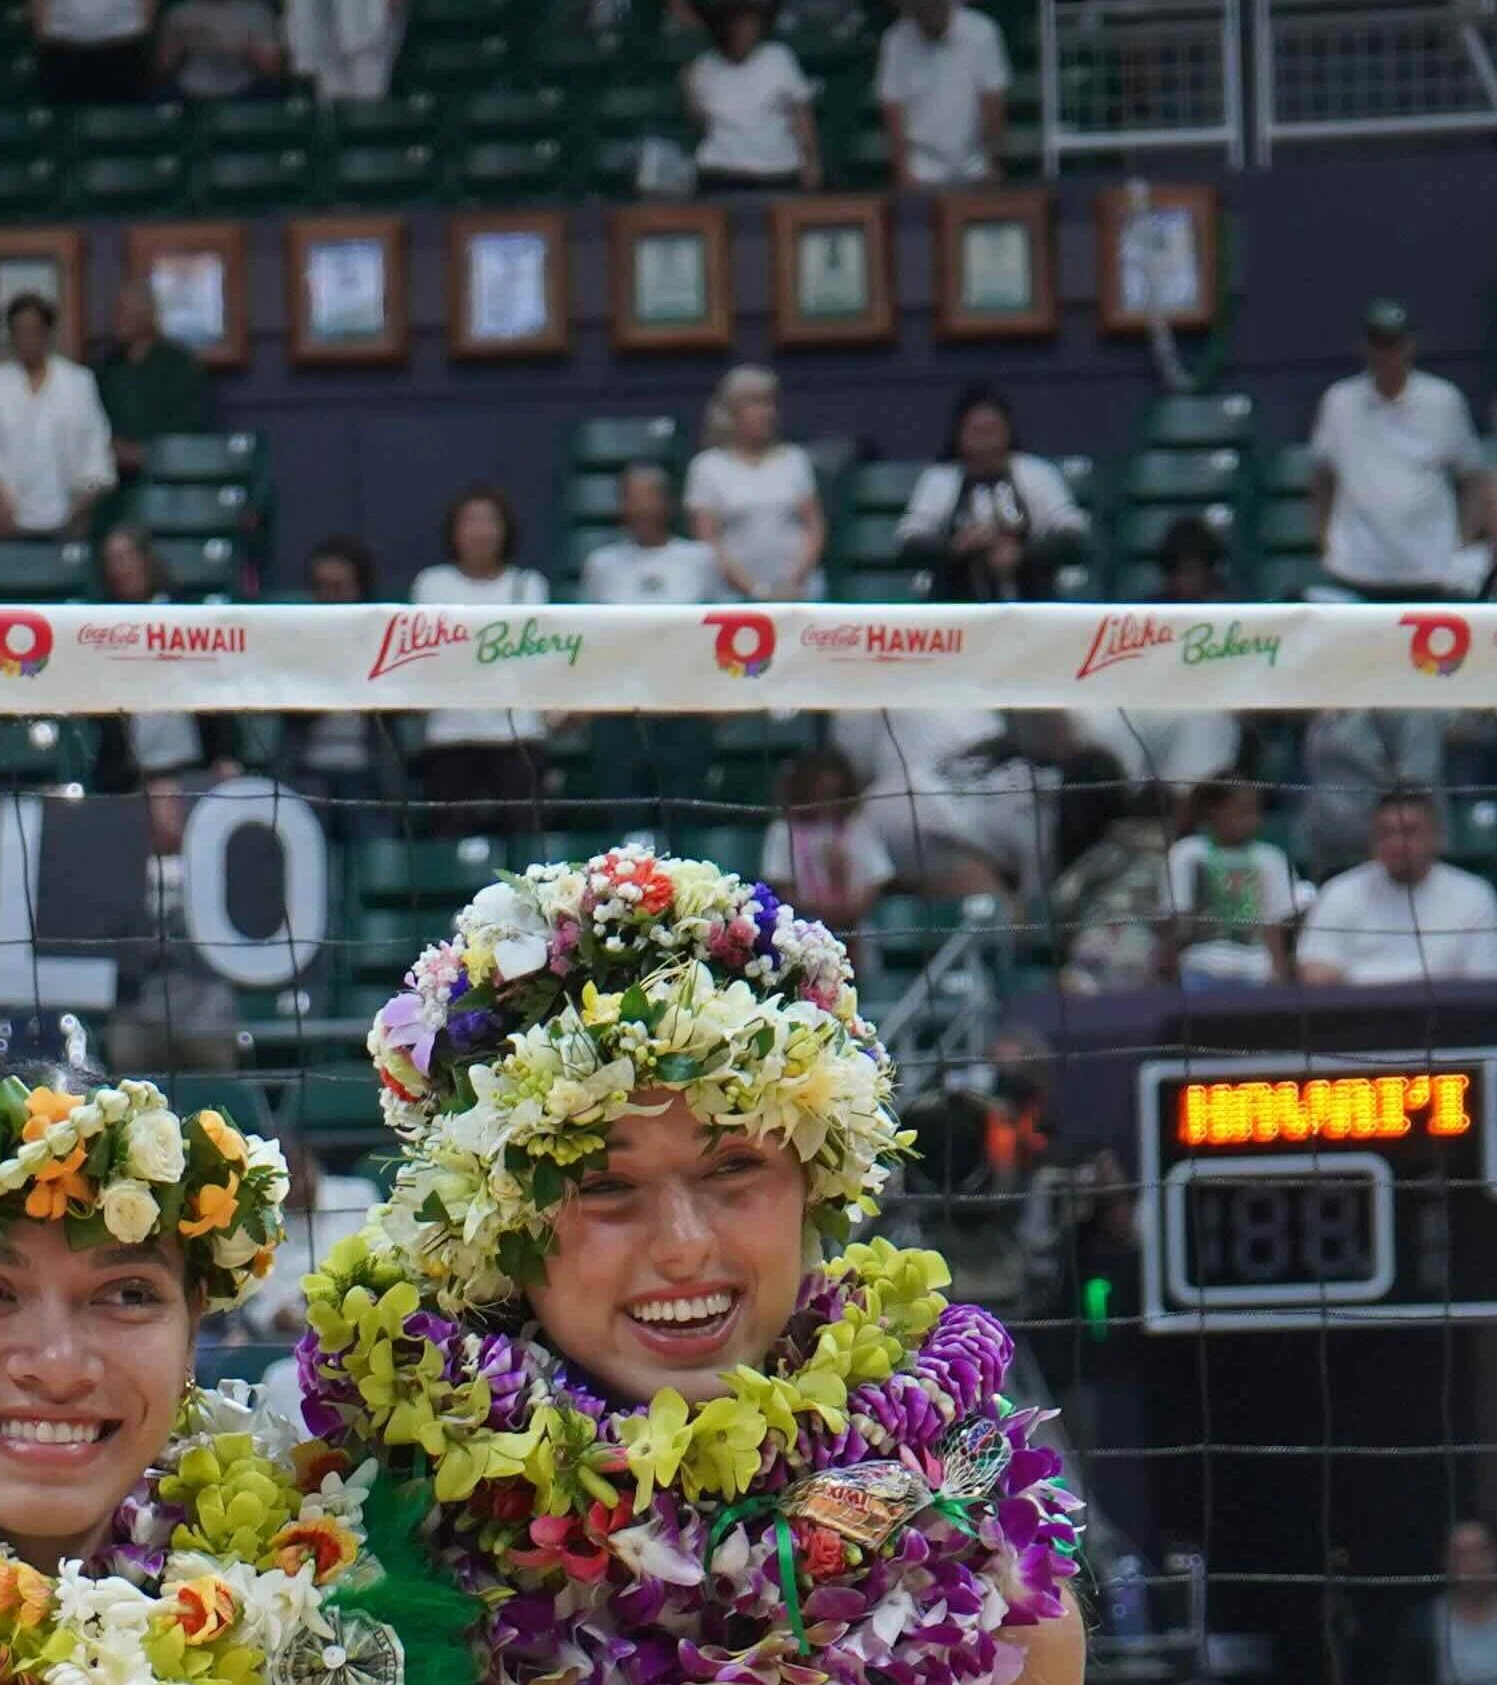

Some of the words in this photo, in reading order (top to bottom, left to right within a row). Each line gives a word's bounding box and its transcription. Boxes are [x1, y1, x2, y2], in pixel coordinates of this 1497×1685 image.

[146, 624, 246, 653] HAWAII
[369, 612, 469, 680] Liliha
[476, 621, 583, 666] Bakery
[867, 625, 962, 654] HAWAII
[1076, 614, 1175, 678] Liliha
[1180, 622, 1282, 666] Bakery
